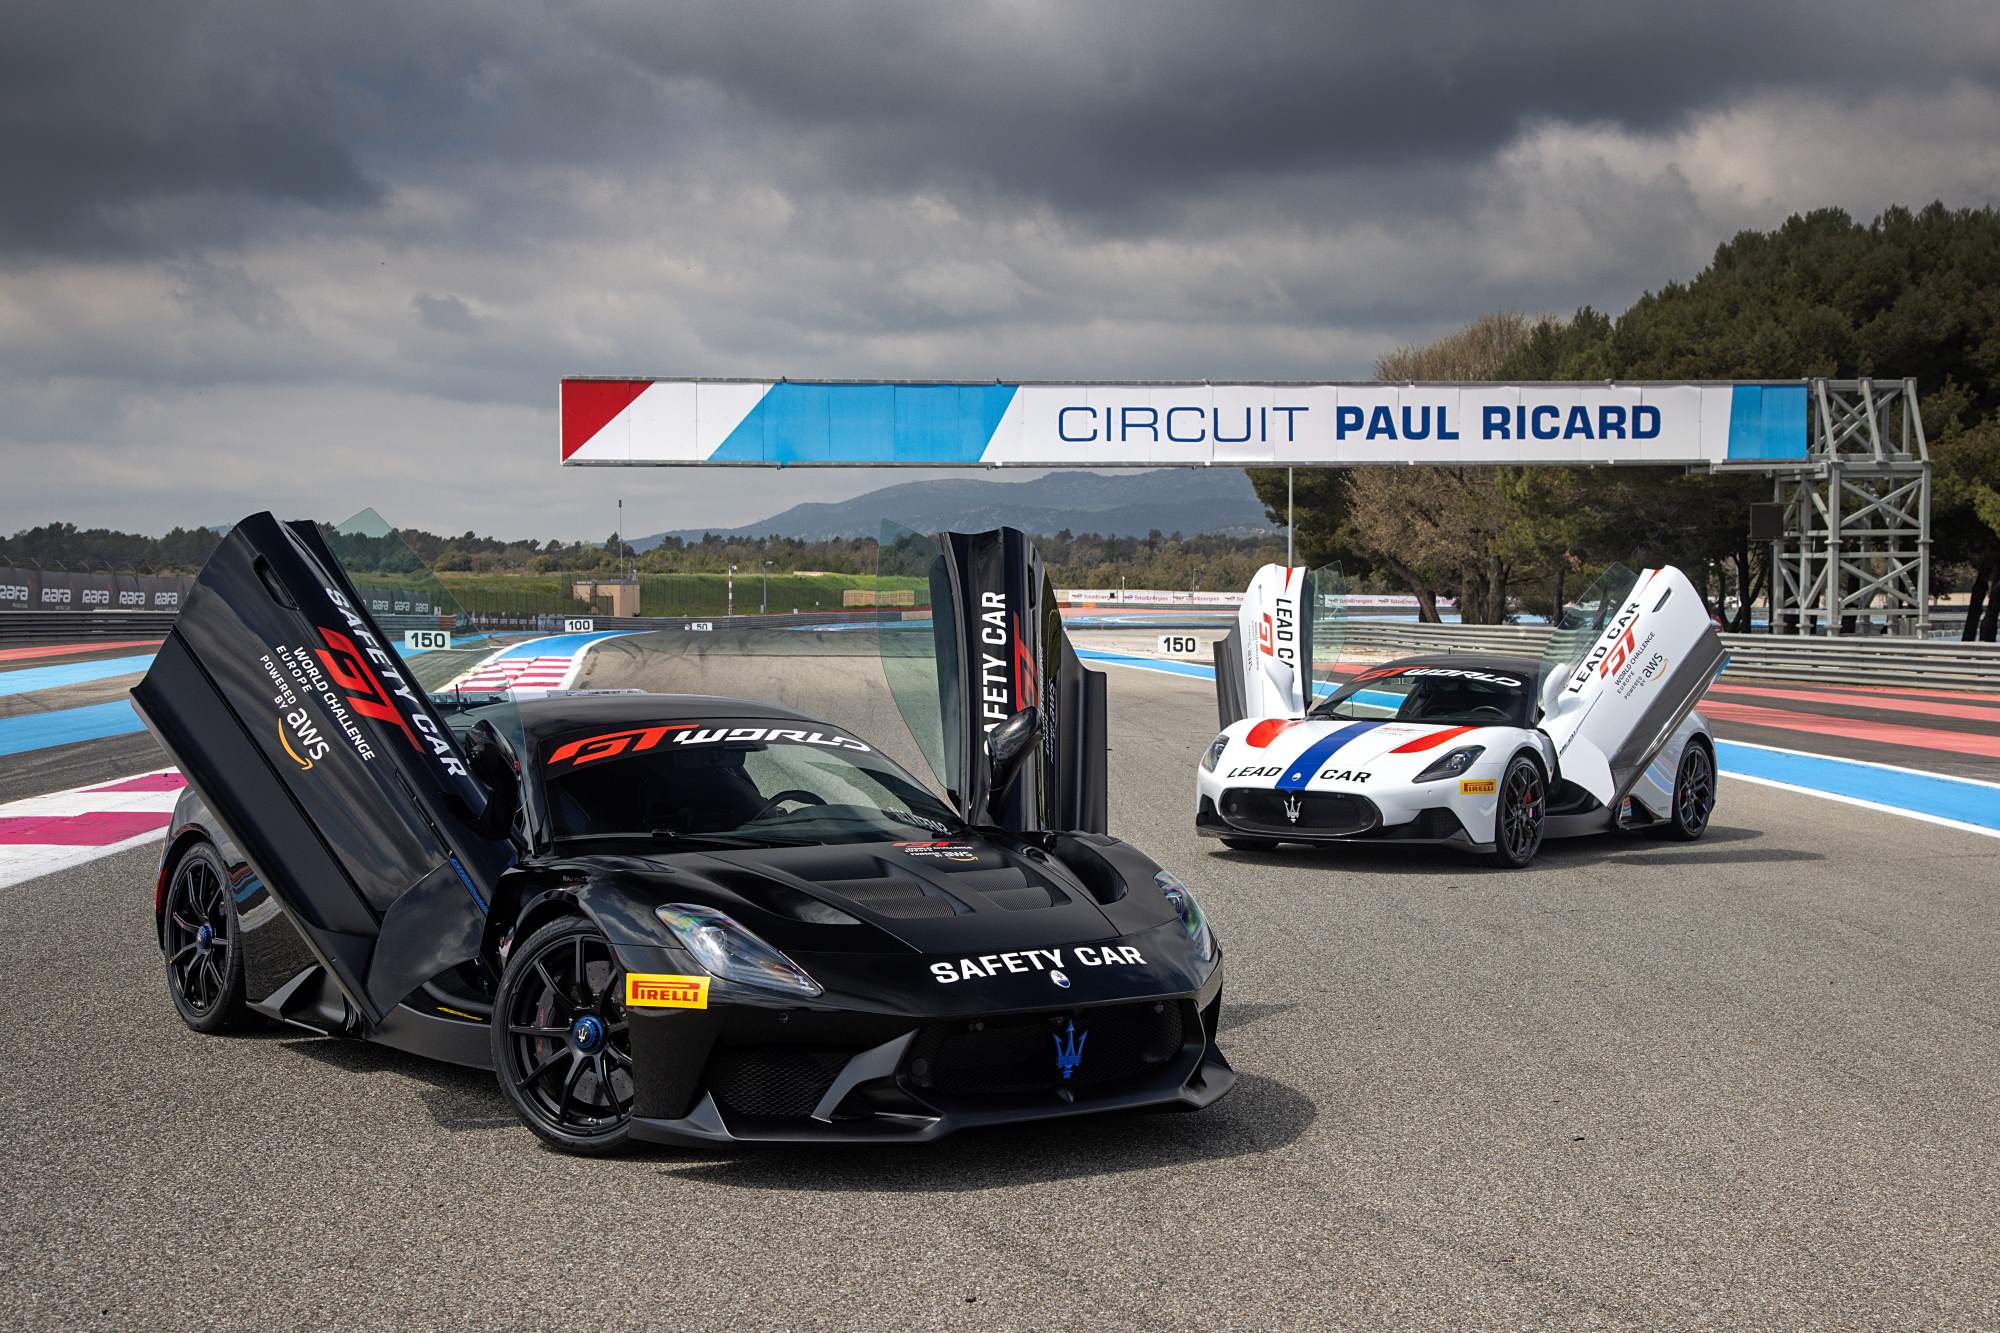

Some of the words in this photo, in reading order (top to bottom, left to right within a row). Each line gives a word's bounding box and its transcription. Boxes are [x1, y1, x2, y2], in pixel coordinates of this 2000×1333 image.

[1058, 406, 1310, 442] CIRCUIT
[1335, 405, 1460, 440] PAUL
[1482, 405, 1662, 440] RICARD
[568, 620, 590, 631] 100
[982, 591, 1006, 646] CAR
[1276, 598, 1293, 642] LEAD
[410, 633, 446, 648] 150
[1163, 637, 1196, 653] 150
[1568, 646, 1608, 693] LEAD
[1607, 603, 1640, 640] CAR
[276, 645, 313, 693] EUROPE
[1614, 661, 1632, 686] WORLD
[1631, 631, 1655, 665] CHALLENGE
[1641, 652, 1663, 678] aws
[260, 655, 297, 705] POWERED
[325, 587, 419, 704] SAFETY
[412, 713, 467, 778] CAR
[1403, 668, 1522, 688] WORLD
[1616, 671, 1635, 695] EUROPE
[1624, 676, 1643, 700] POWERED
[274, 696, 289, 710] BY
[293, 647, 329, 692] WORLD
[323, 692, 375, 761] CHALLENGE
[982, 653, 1008, 756] FETY
[287, 708, 330, 761] aws
[672, 728, 872, 753] WORLD
[1226, 766, 1284, 779] LEAD
[1319, 769, 1373, 784] CAR
[1463, 782, 1495, 793] PIRELLI
[929, 948, 1066, 984] SAFETY
[1073, 946, 1148, 967] CAR
[632, 980, 700, 1002] PIRELLI
